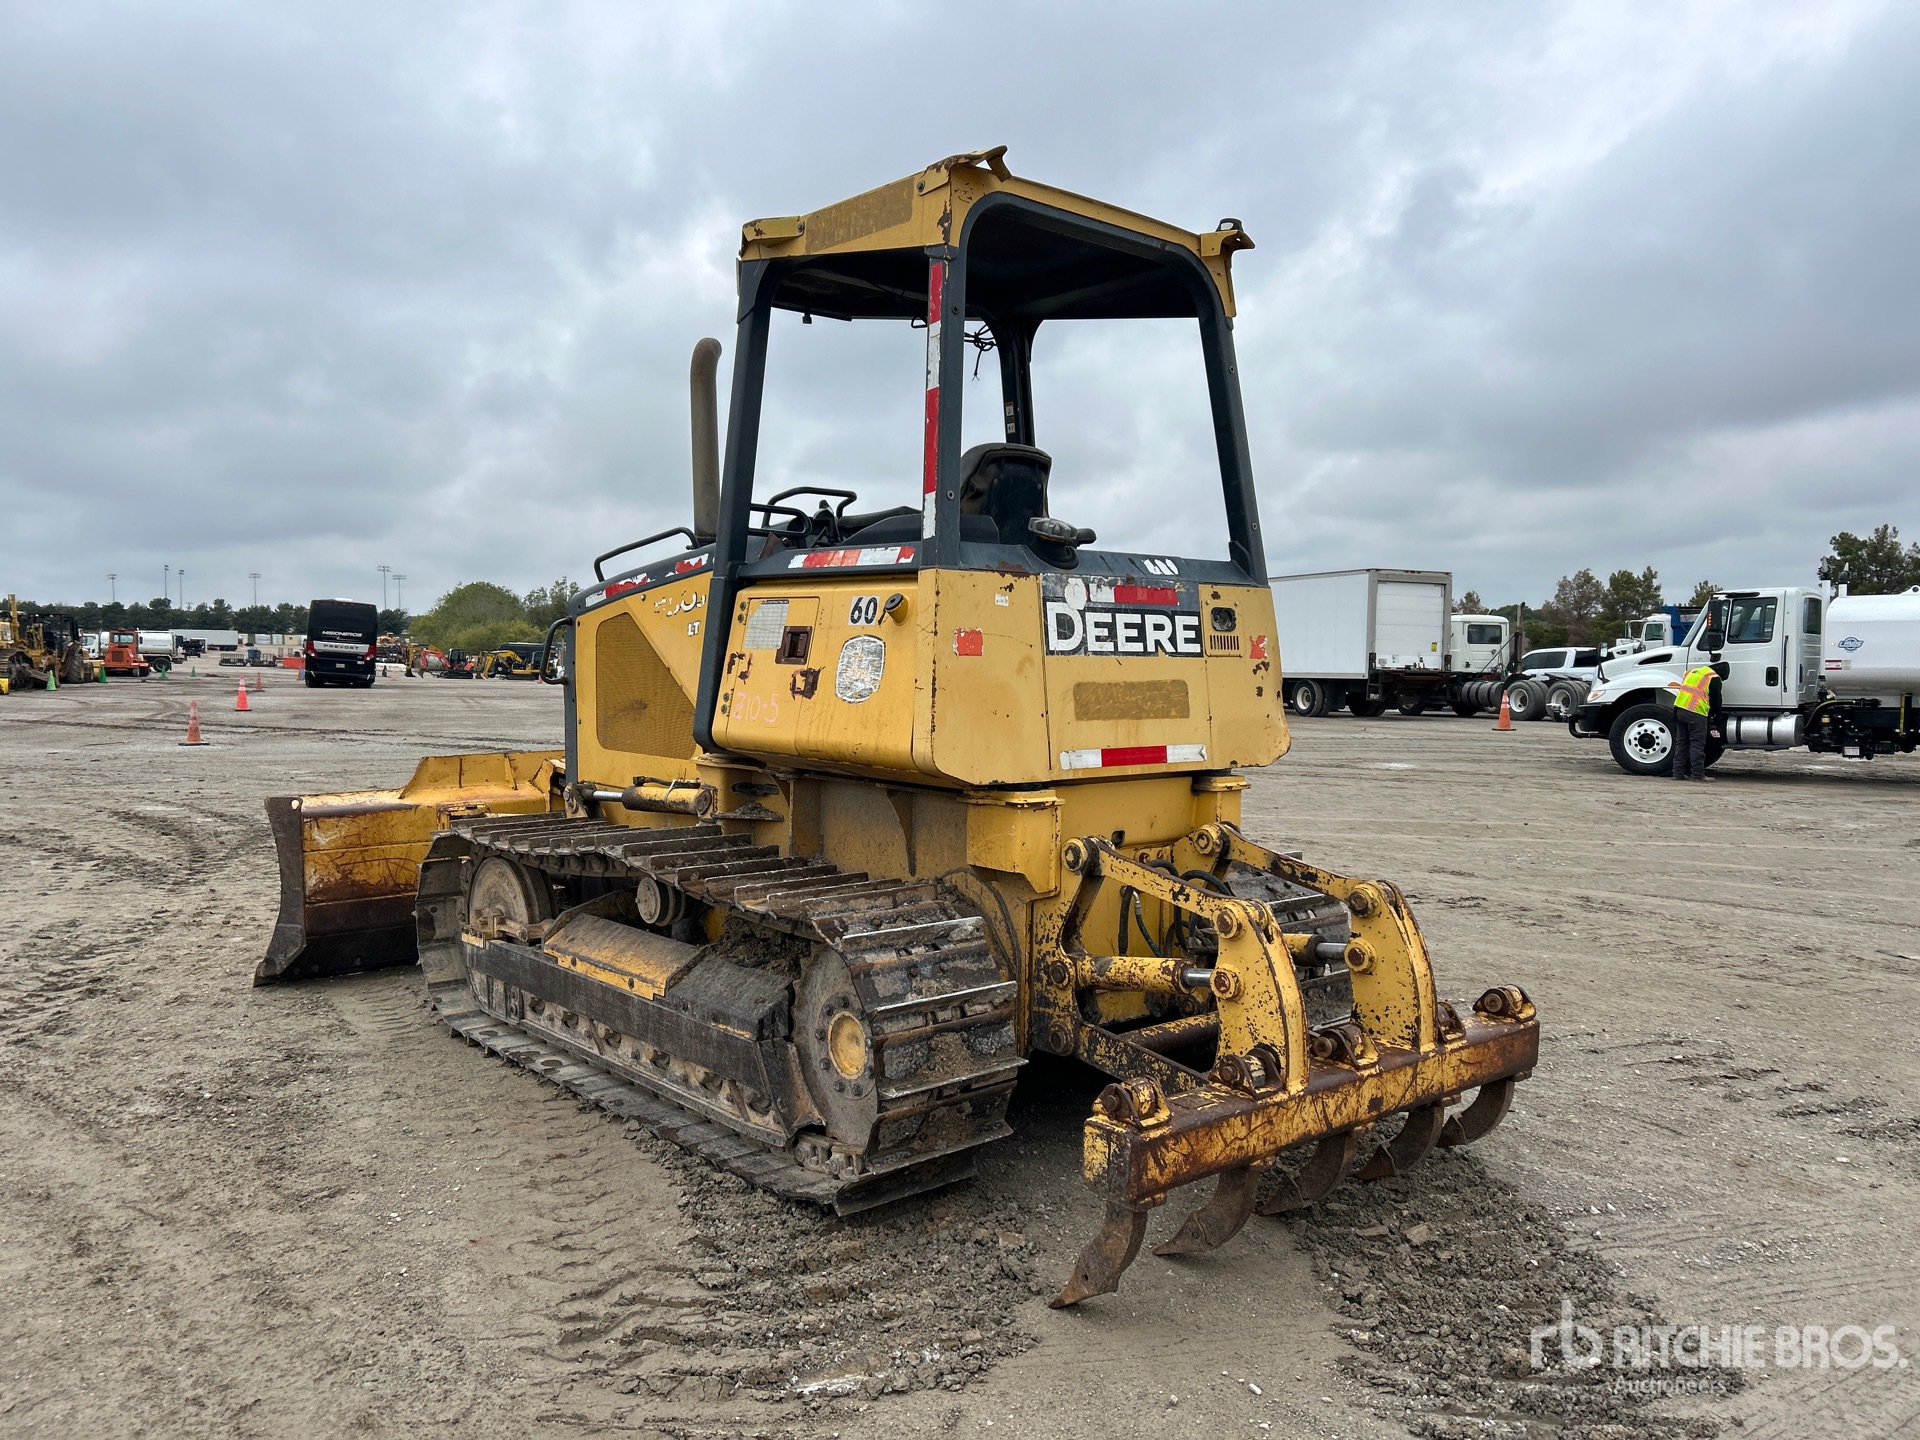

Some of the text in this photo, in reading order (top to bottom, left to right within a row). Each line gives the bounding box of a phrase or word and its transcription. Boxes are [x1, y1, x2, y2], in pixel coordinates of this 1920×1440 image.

[850, 597, 878, 625] 60
[688, 620, 701, 637] LT
[1046, 602, 1200, 653] DEERE
